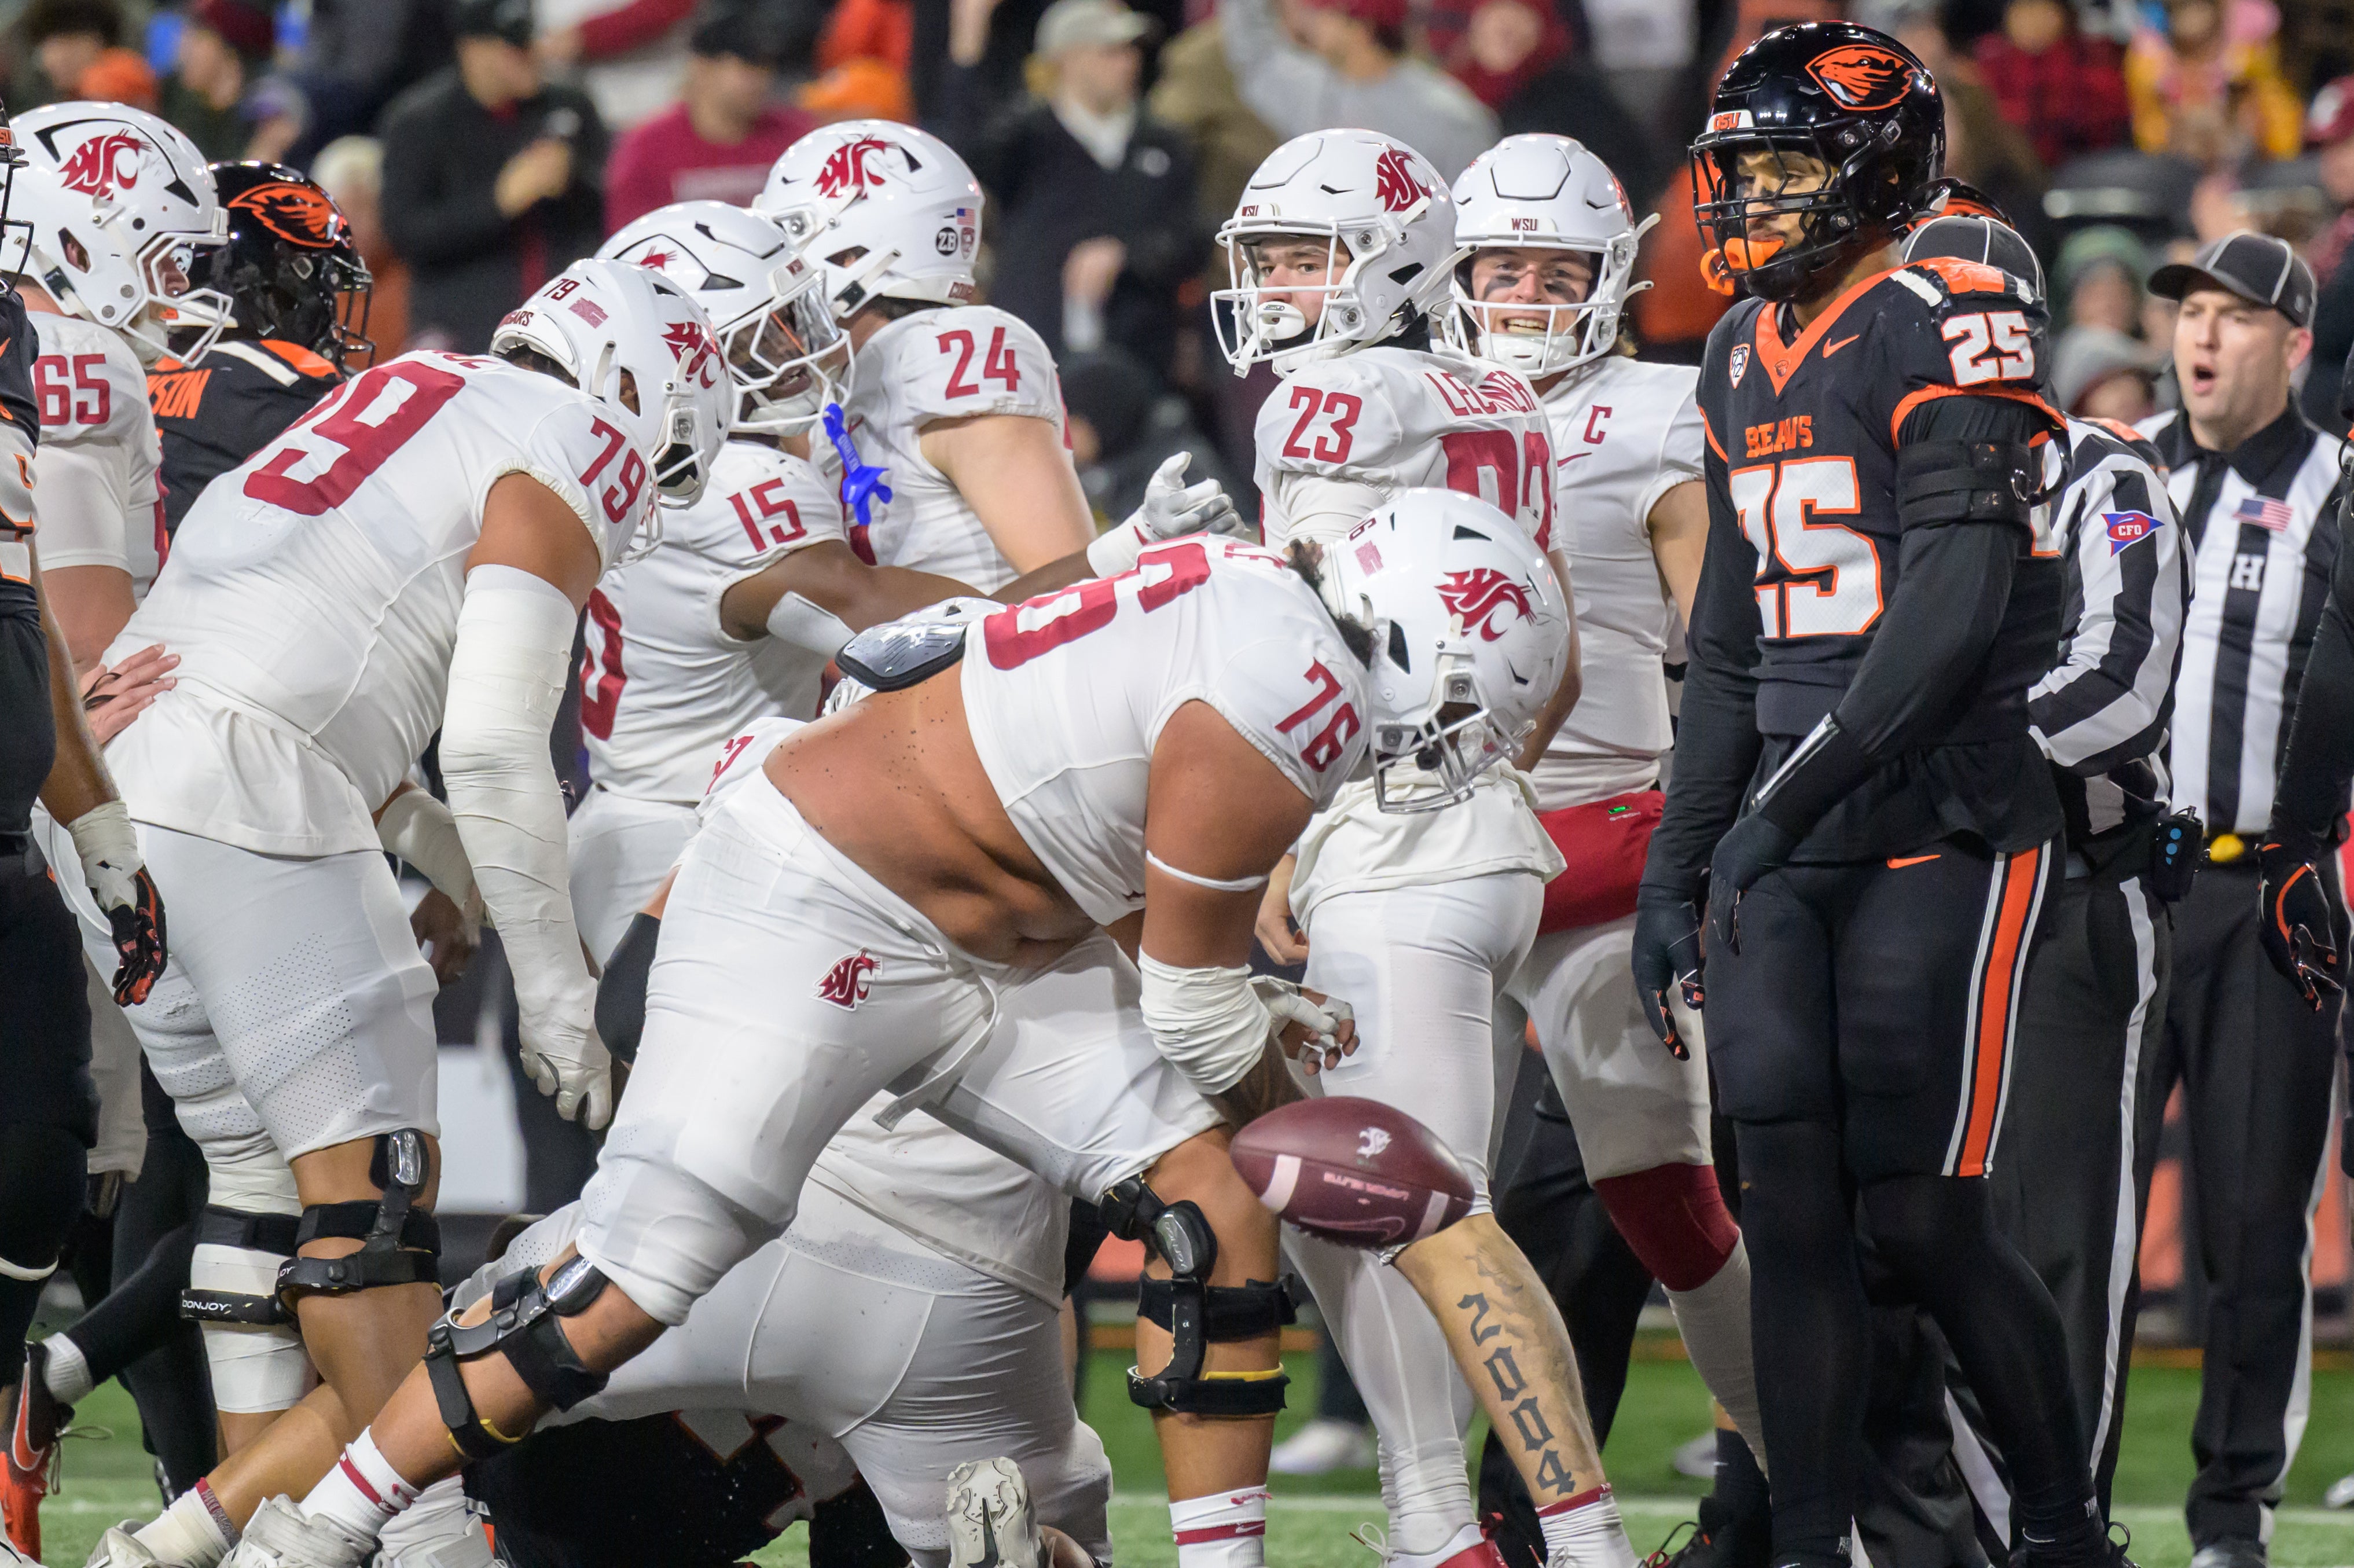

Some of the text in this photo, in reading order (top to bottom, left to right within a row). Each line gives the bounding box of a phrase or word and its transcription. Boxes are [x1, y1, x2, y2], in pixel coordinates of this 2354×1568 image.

[0, 128, 12, 145] SU
[1714, 112, 1741, 131] OSU
[1511, 218, 1538, 231] WSU
[543, 278, 581, 301] 79
[938, 327, 1020, 399] 24
[1941, 311, 2035, 387] 25
[34, 354, 110, 425] 65
[1282, 385, 1362, 464] 23
[1584, 405, 1612, 445] C
[1745, 416, 1813, 458] BEAVS
[578, 416, 647, 524] 79
[727, 477, 807, 552] 15
[2118, 524, 2142, 536] CFO
[2230, 554, 2264, 591] H
[1275, 656, 1360, 773] 76
[1457, 1292, 1577, 1496] 2004
